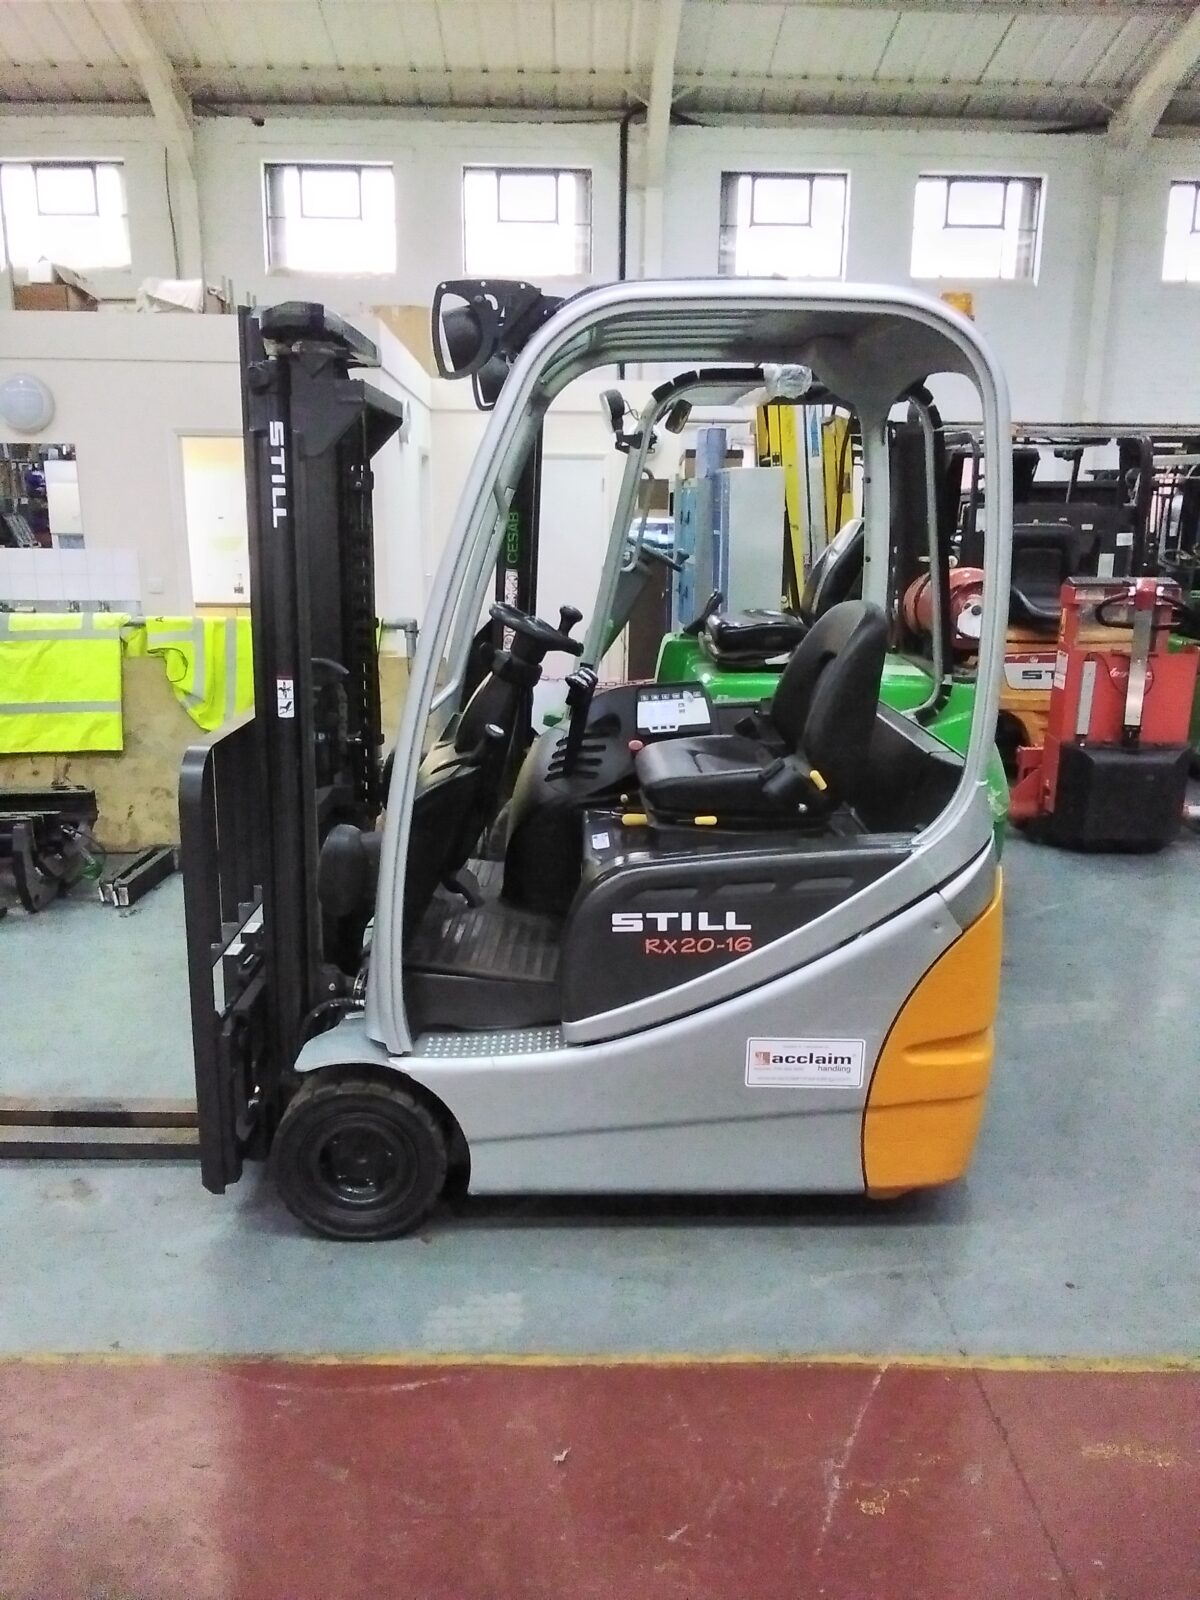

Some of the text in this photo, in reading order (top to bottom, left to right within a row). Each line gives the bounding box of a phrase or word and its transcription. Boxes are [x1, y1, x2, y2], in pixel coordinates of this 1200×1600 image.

[270, 421, 287, 528] STILL
[506, 512, 519, 564] CESAB
[612, 911, 752, 932] STILL
[645, 936, 752, 954] RX20-16
[772, 1053, 852, 1065] acclaim
